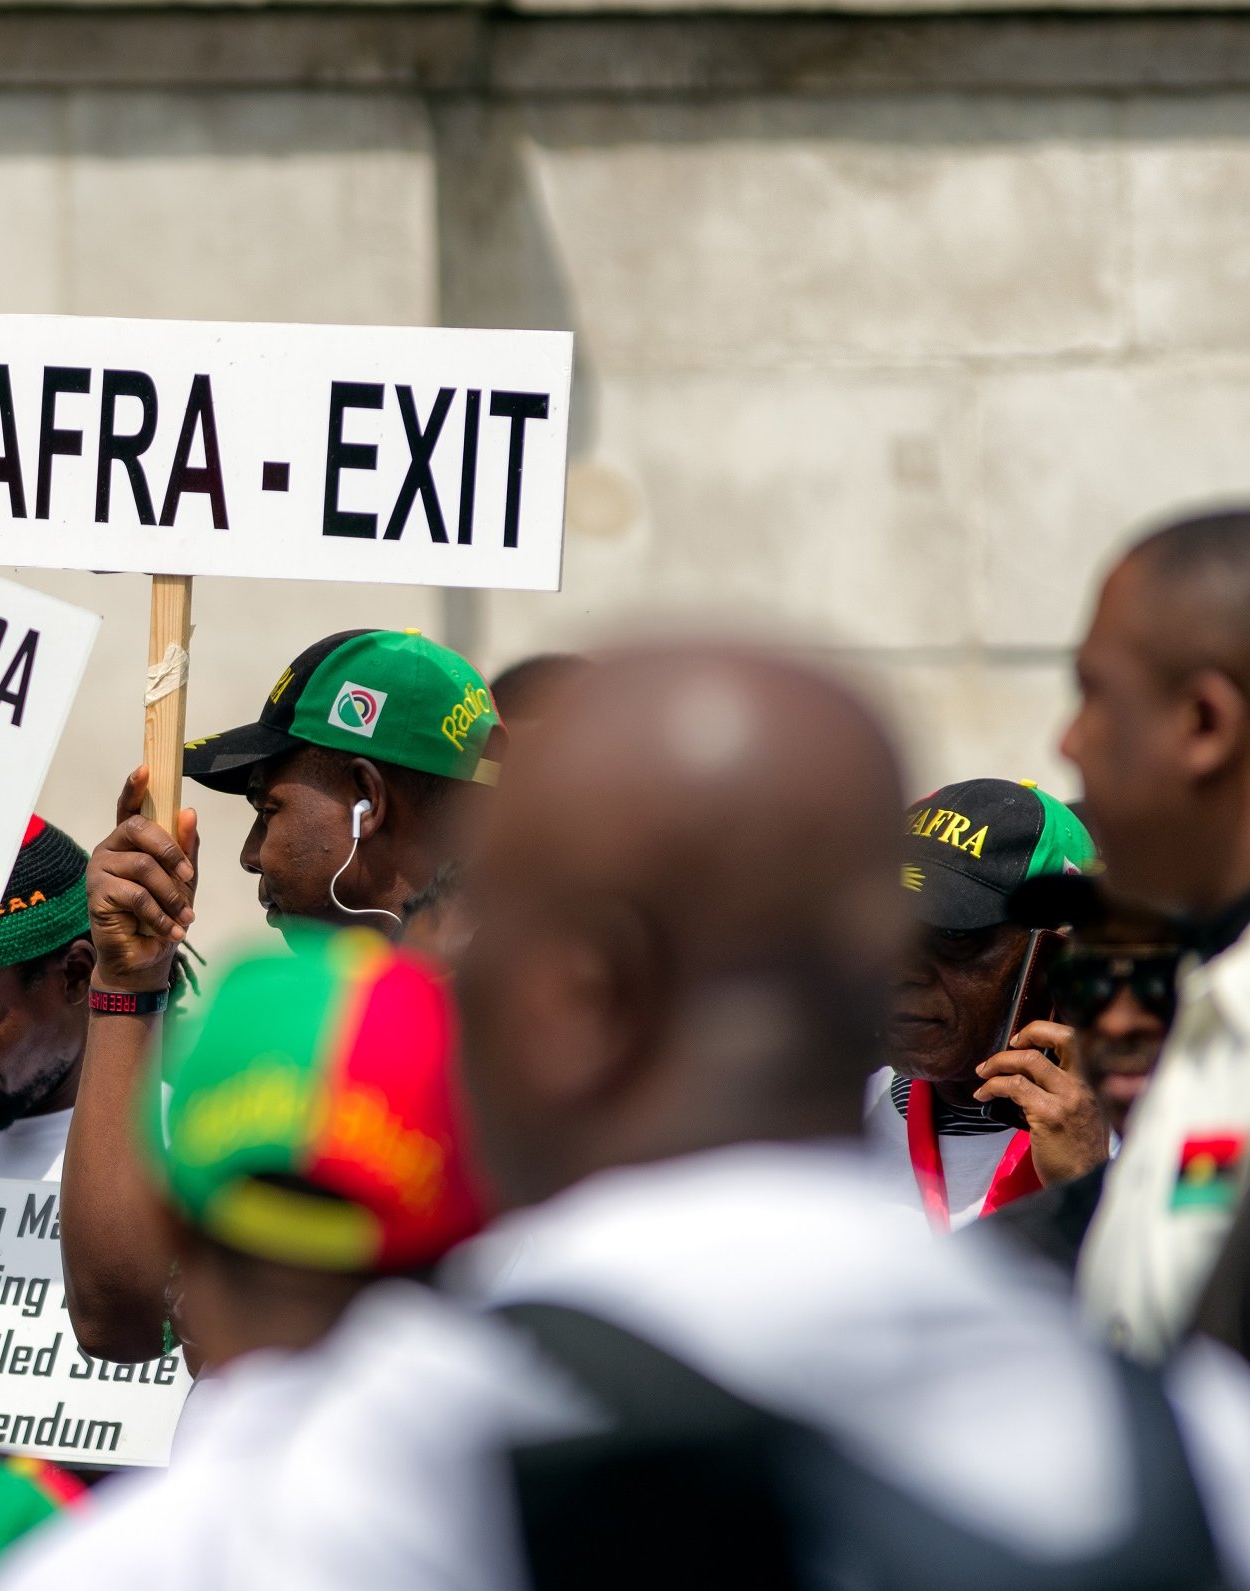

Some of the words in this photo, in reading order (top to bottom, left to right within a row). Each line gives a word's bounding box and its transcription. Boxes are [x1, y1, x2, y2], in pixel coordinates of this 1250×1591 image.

[262, 461, 290, 492] -
[322, 380, 550, 549] EXIT
[441, 682, 491, 751] Radio
[906, 807, 989, 859] AFRA
